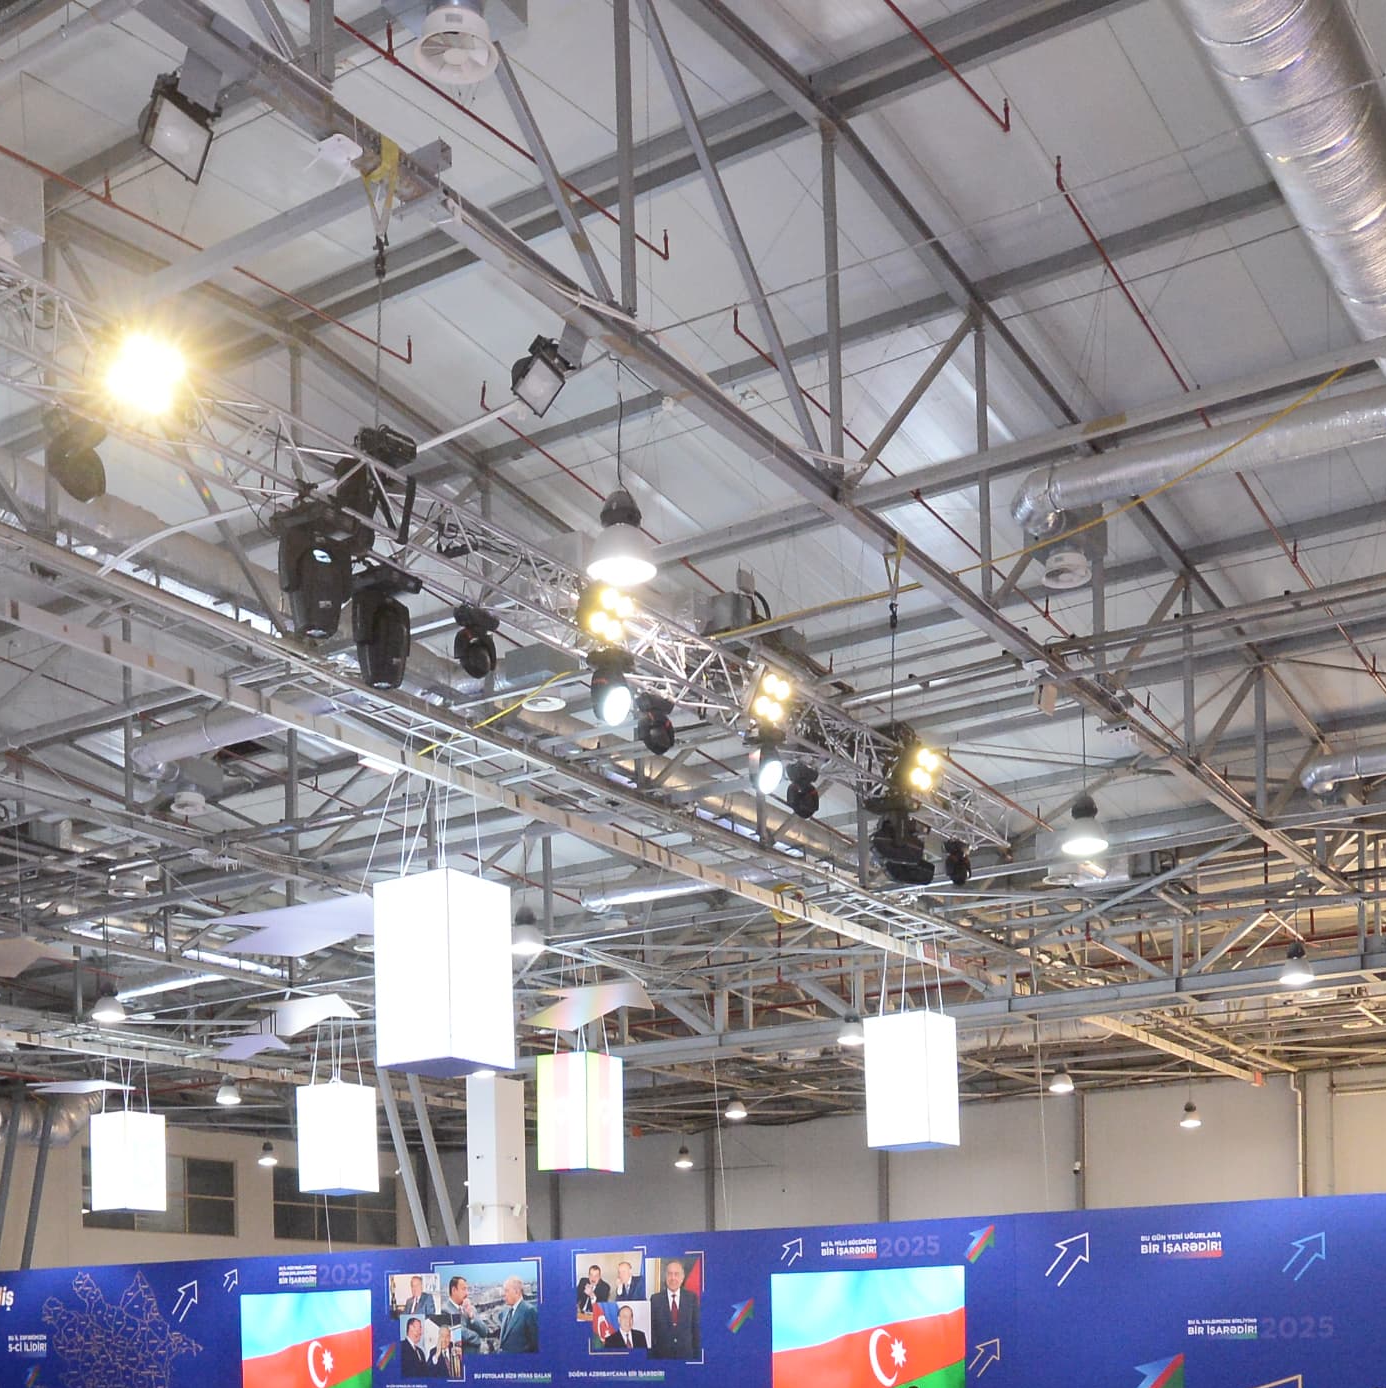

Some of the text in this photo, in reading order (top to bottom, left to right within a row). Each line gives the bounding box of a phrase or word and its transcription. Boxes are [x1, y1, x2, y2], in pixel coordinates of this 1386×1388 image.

[880, 1235, 941, 1258] 2025
[1140, 1240, 1222, 1255] BİR İŞARƏDİR!
[319, 1263, 373, 1285] 2025
[1188, 1324, 1258, 1336] BİR İŞARƏDİR!
[1264, 1316, 1334, 1338] 2025
